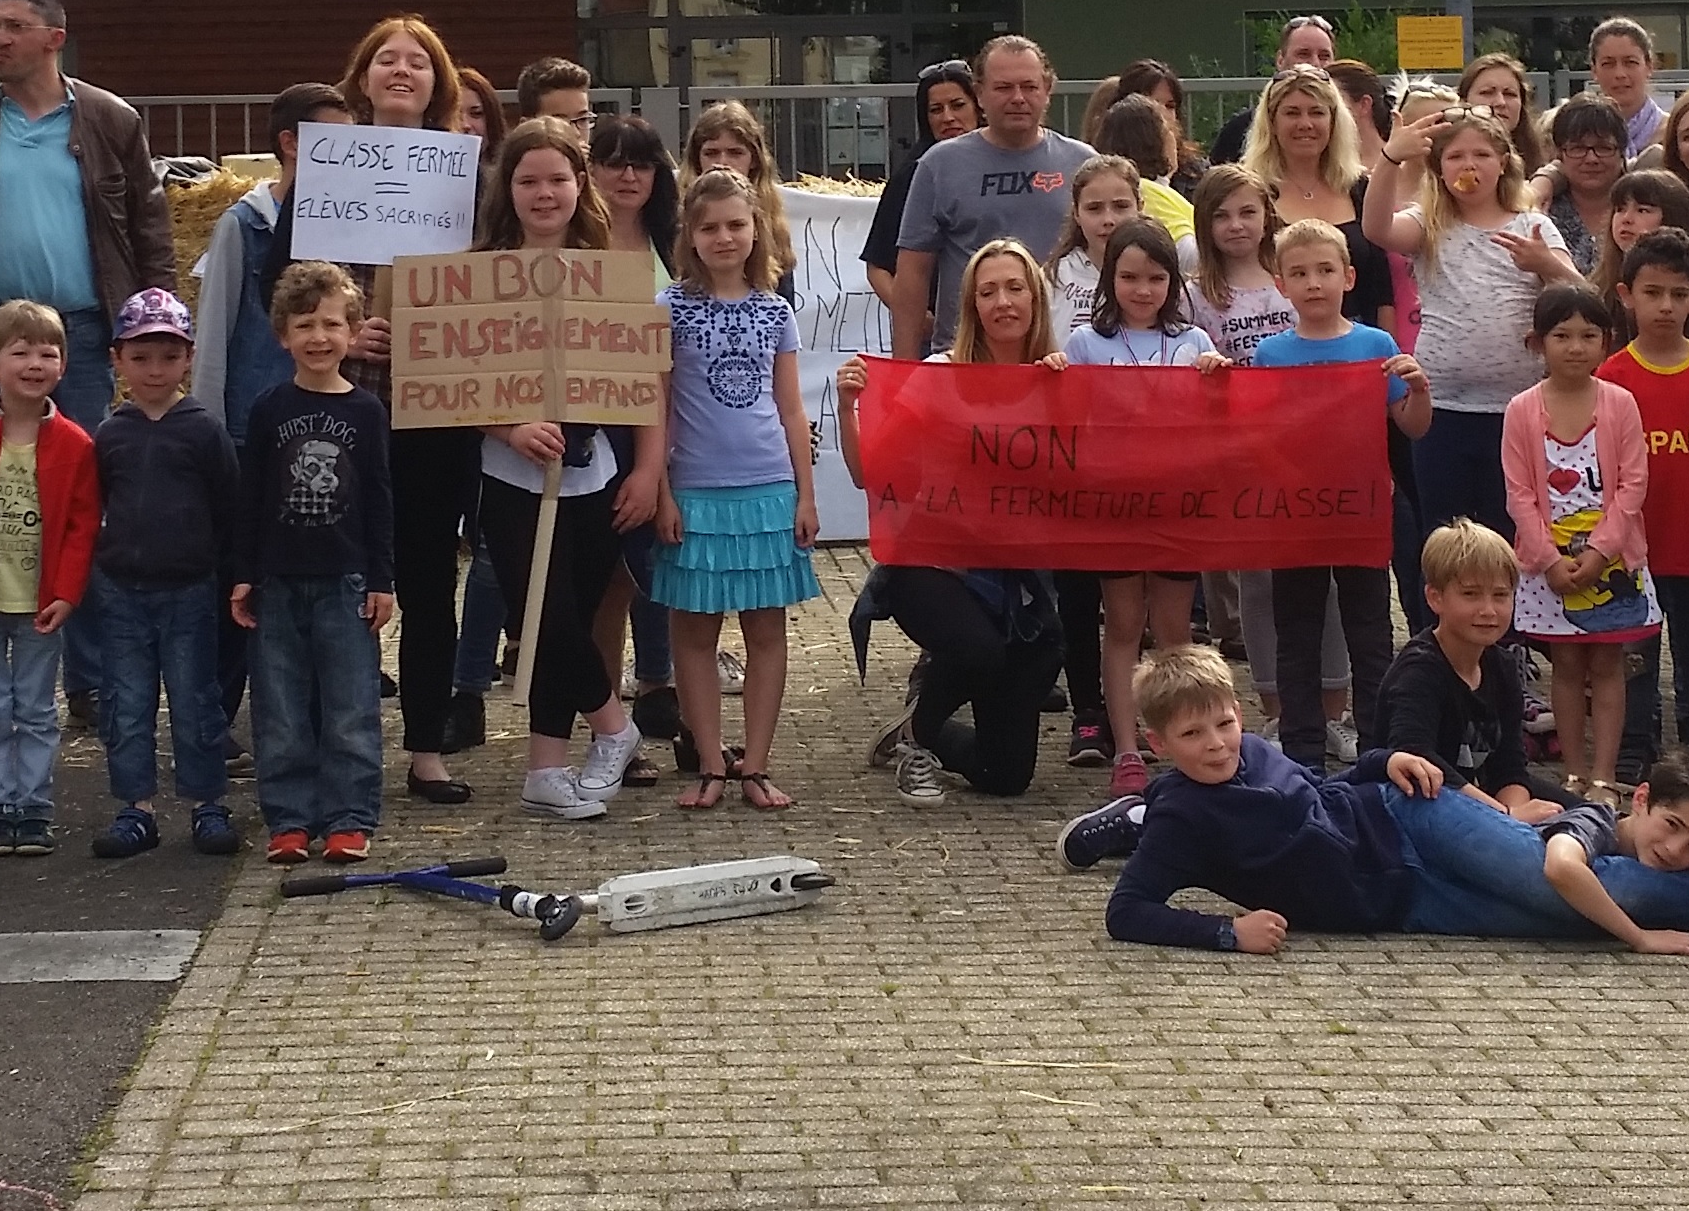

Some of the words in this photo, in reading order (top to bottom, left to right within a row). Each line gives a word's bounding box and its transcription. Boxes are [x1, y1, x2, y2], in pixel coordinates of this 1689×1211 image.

[310, 137, 395, 171] CLASSE
[406, 144, 468, 178] FERMÉE
[981, 171, 1038, 197] FOX
[408, 263, 473, 307] UN
[493, 254, 603, 301] BON
[1221, 310, 1291, 335] #SUMMER
[400, 377, 481, 411] POUR
[494, 374, 545, 409] NOS
[970, 424, 1079, 472] NON
[878, 482, 899, 512] A
[925, 485, 964, 515] LA
[990, 486, 1166, 519] FERMETURE
